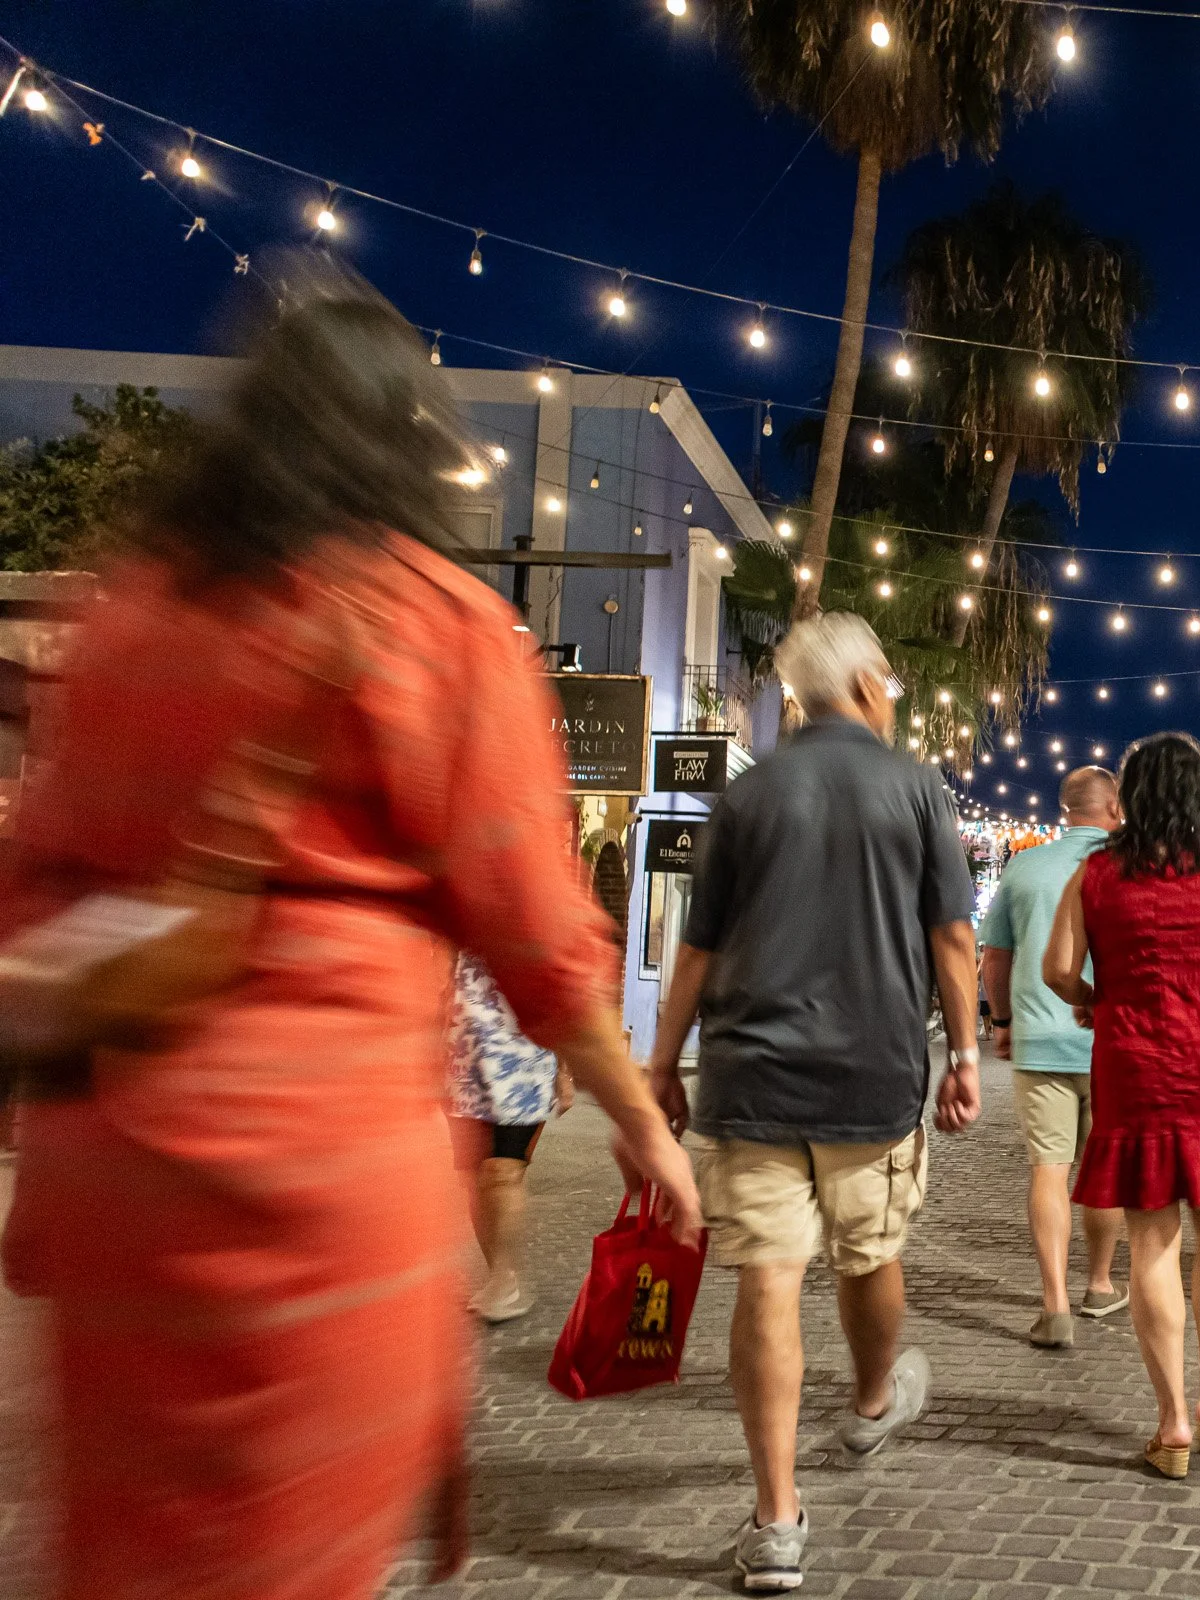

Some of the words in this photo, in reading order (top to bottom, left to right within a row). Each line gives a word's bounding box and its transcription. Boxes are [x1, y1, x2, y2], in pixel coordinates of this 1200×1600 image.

[551, 740, 635, 754] ECRETO
[675, 770, 705, 780] FIRM
[659, 848, 668, 857] El
